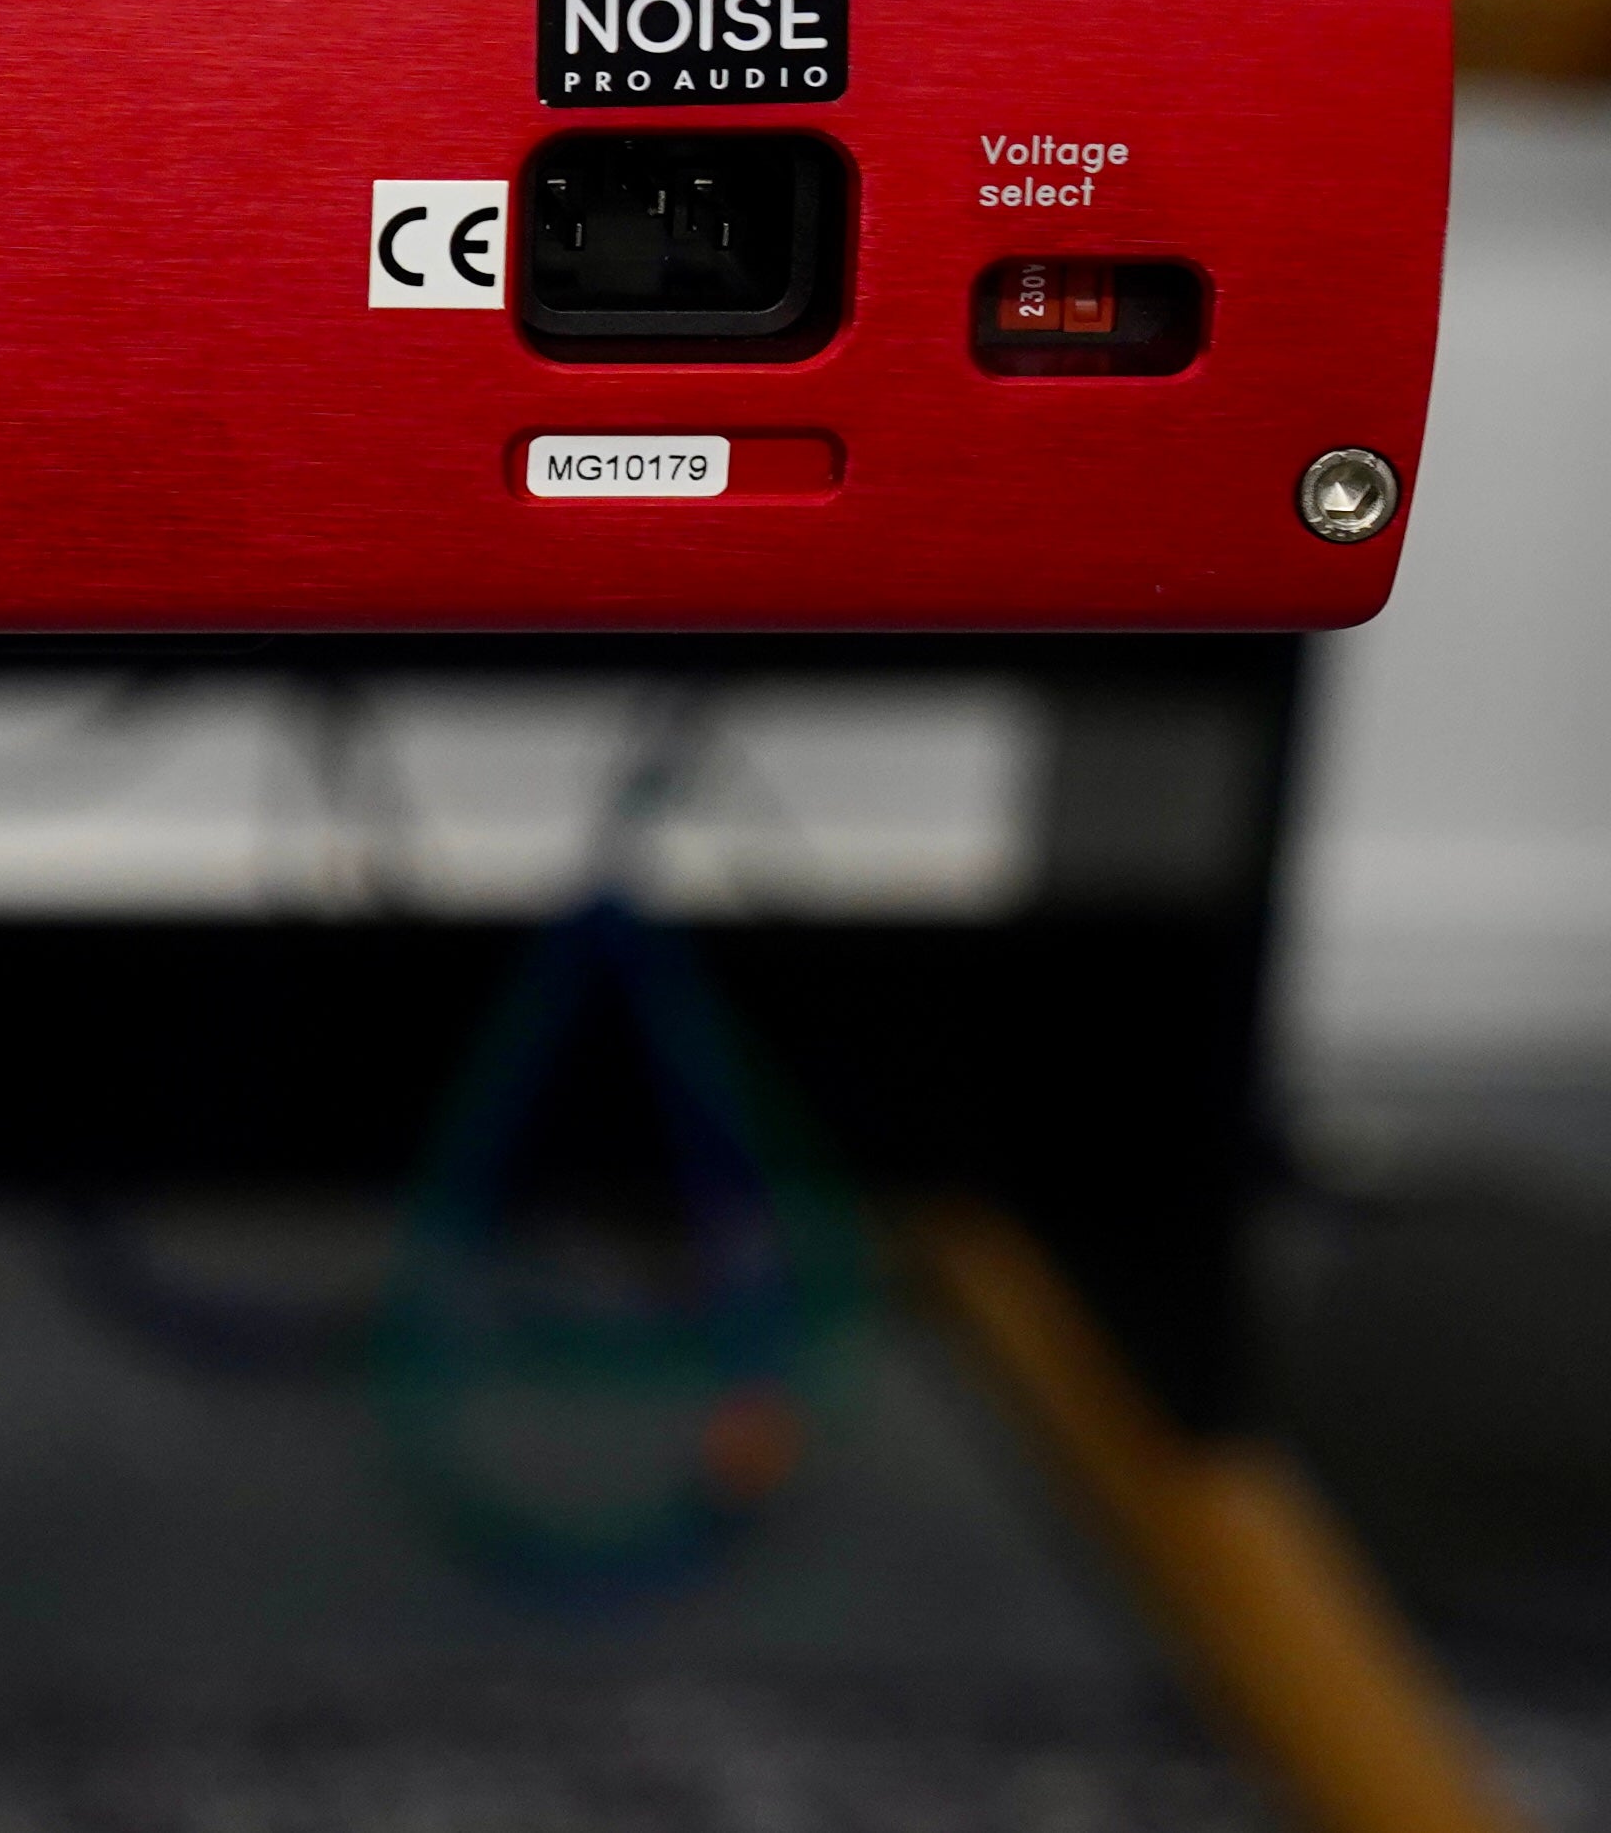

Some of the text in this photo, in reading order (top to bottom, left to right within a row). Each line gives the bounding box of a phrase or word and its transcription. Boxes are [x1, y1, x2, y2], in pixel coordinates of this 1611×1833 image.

[564, 66, 828, 93] PRO AUDIO
[980, 135, 1129, 173] Voltage
[979, 176, 1095, 207] select
[378, 206, 499, 288] CE
[548, 454, 707, 481] MG10179
